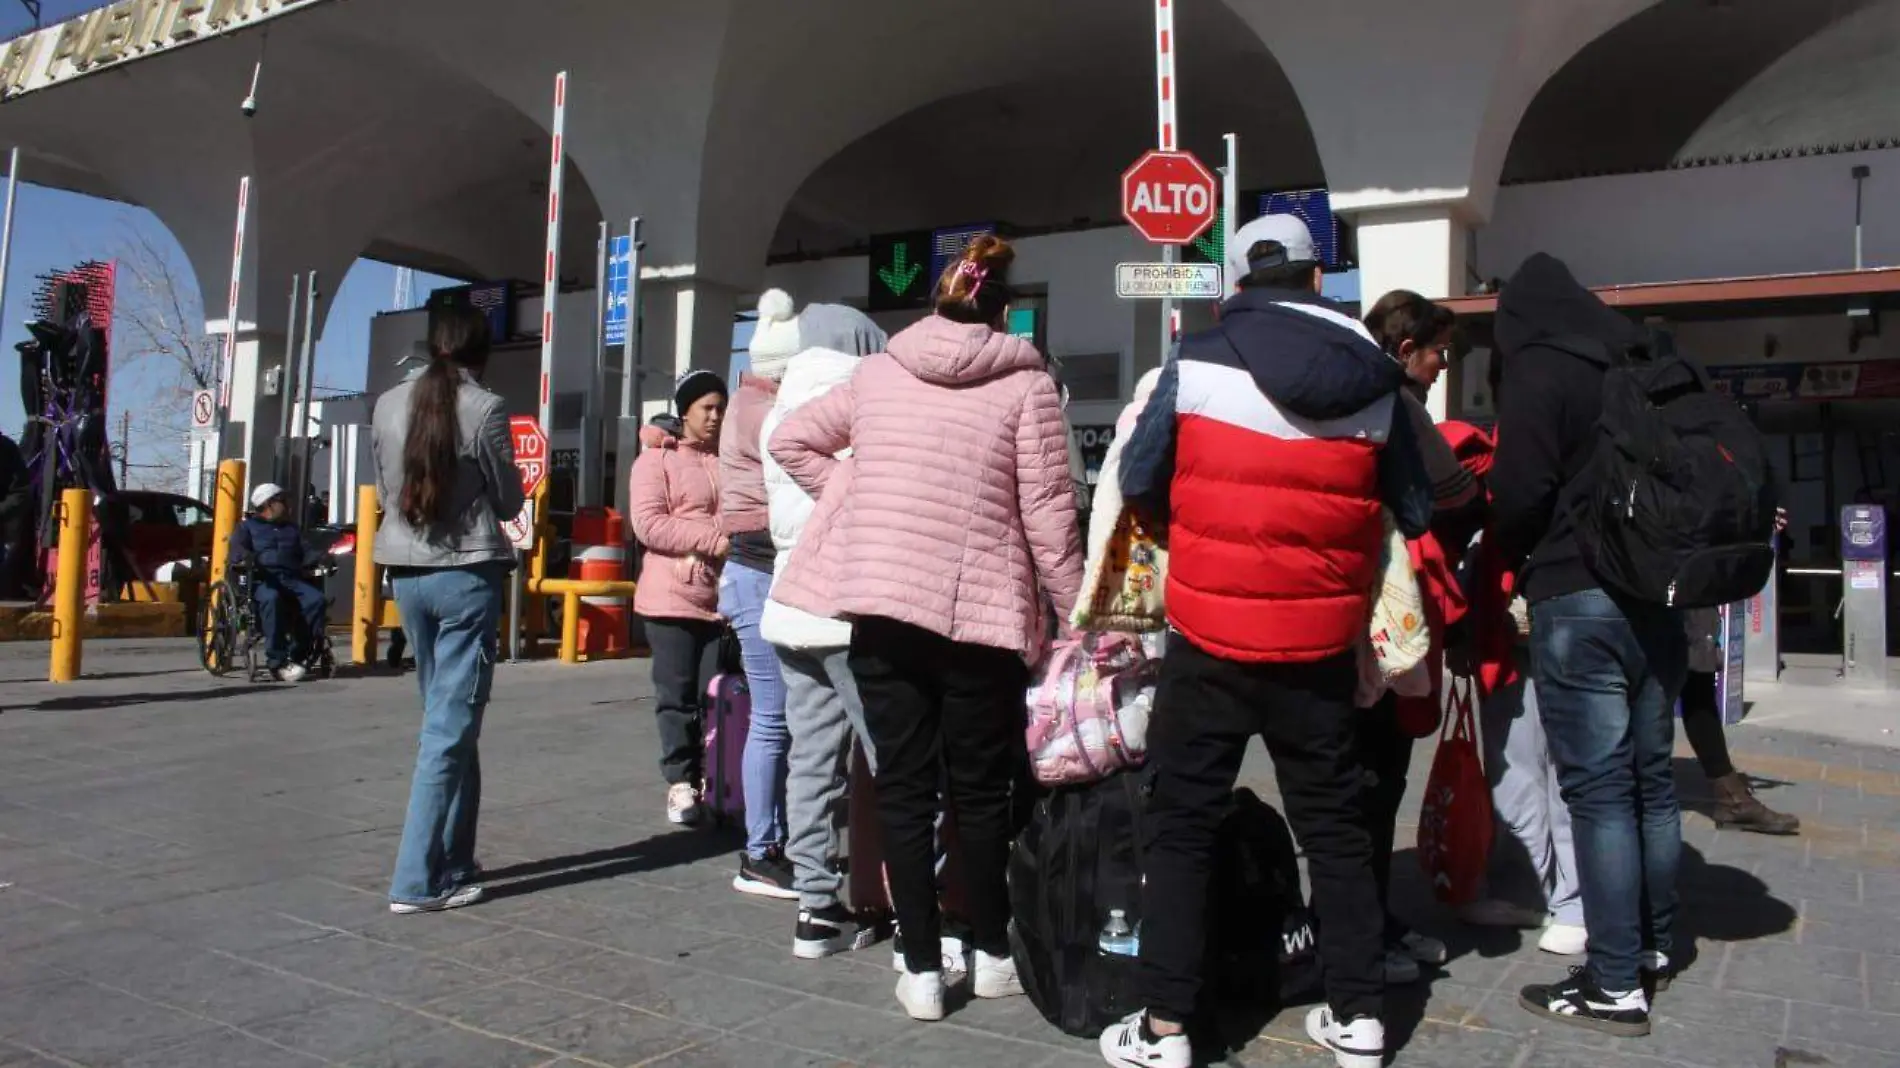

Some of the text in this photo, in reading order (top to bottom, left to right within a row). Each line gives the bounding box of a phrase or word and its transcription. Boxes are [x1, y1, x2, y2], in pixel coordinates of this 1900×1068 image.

[1131, 182, 1208, 215] ALTO
[1133, 268, 1204, 279] PROHIBIDA
[516, 434, 539, 455] TO
[519, 463, 540, 484] OP
